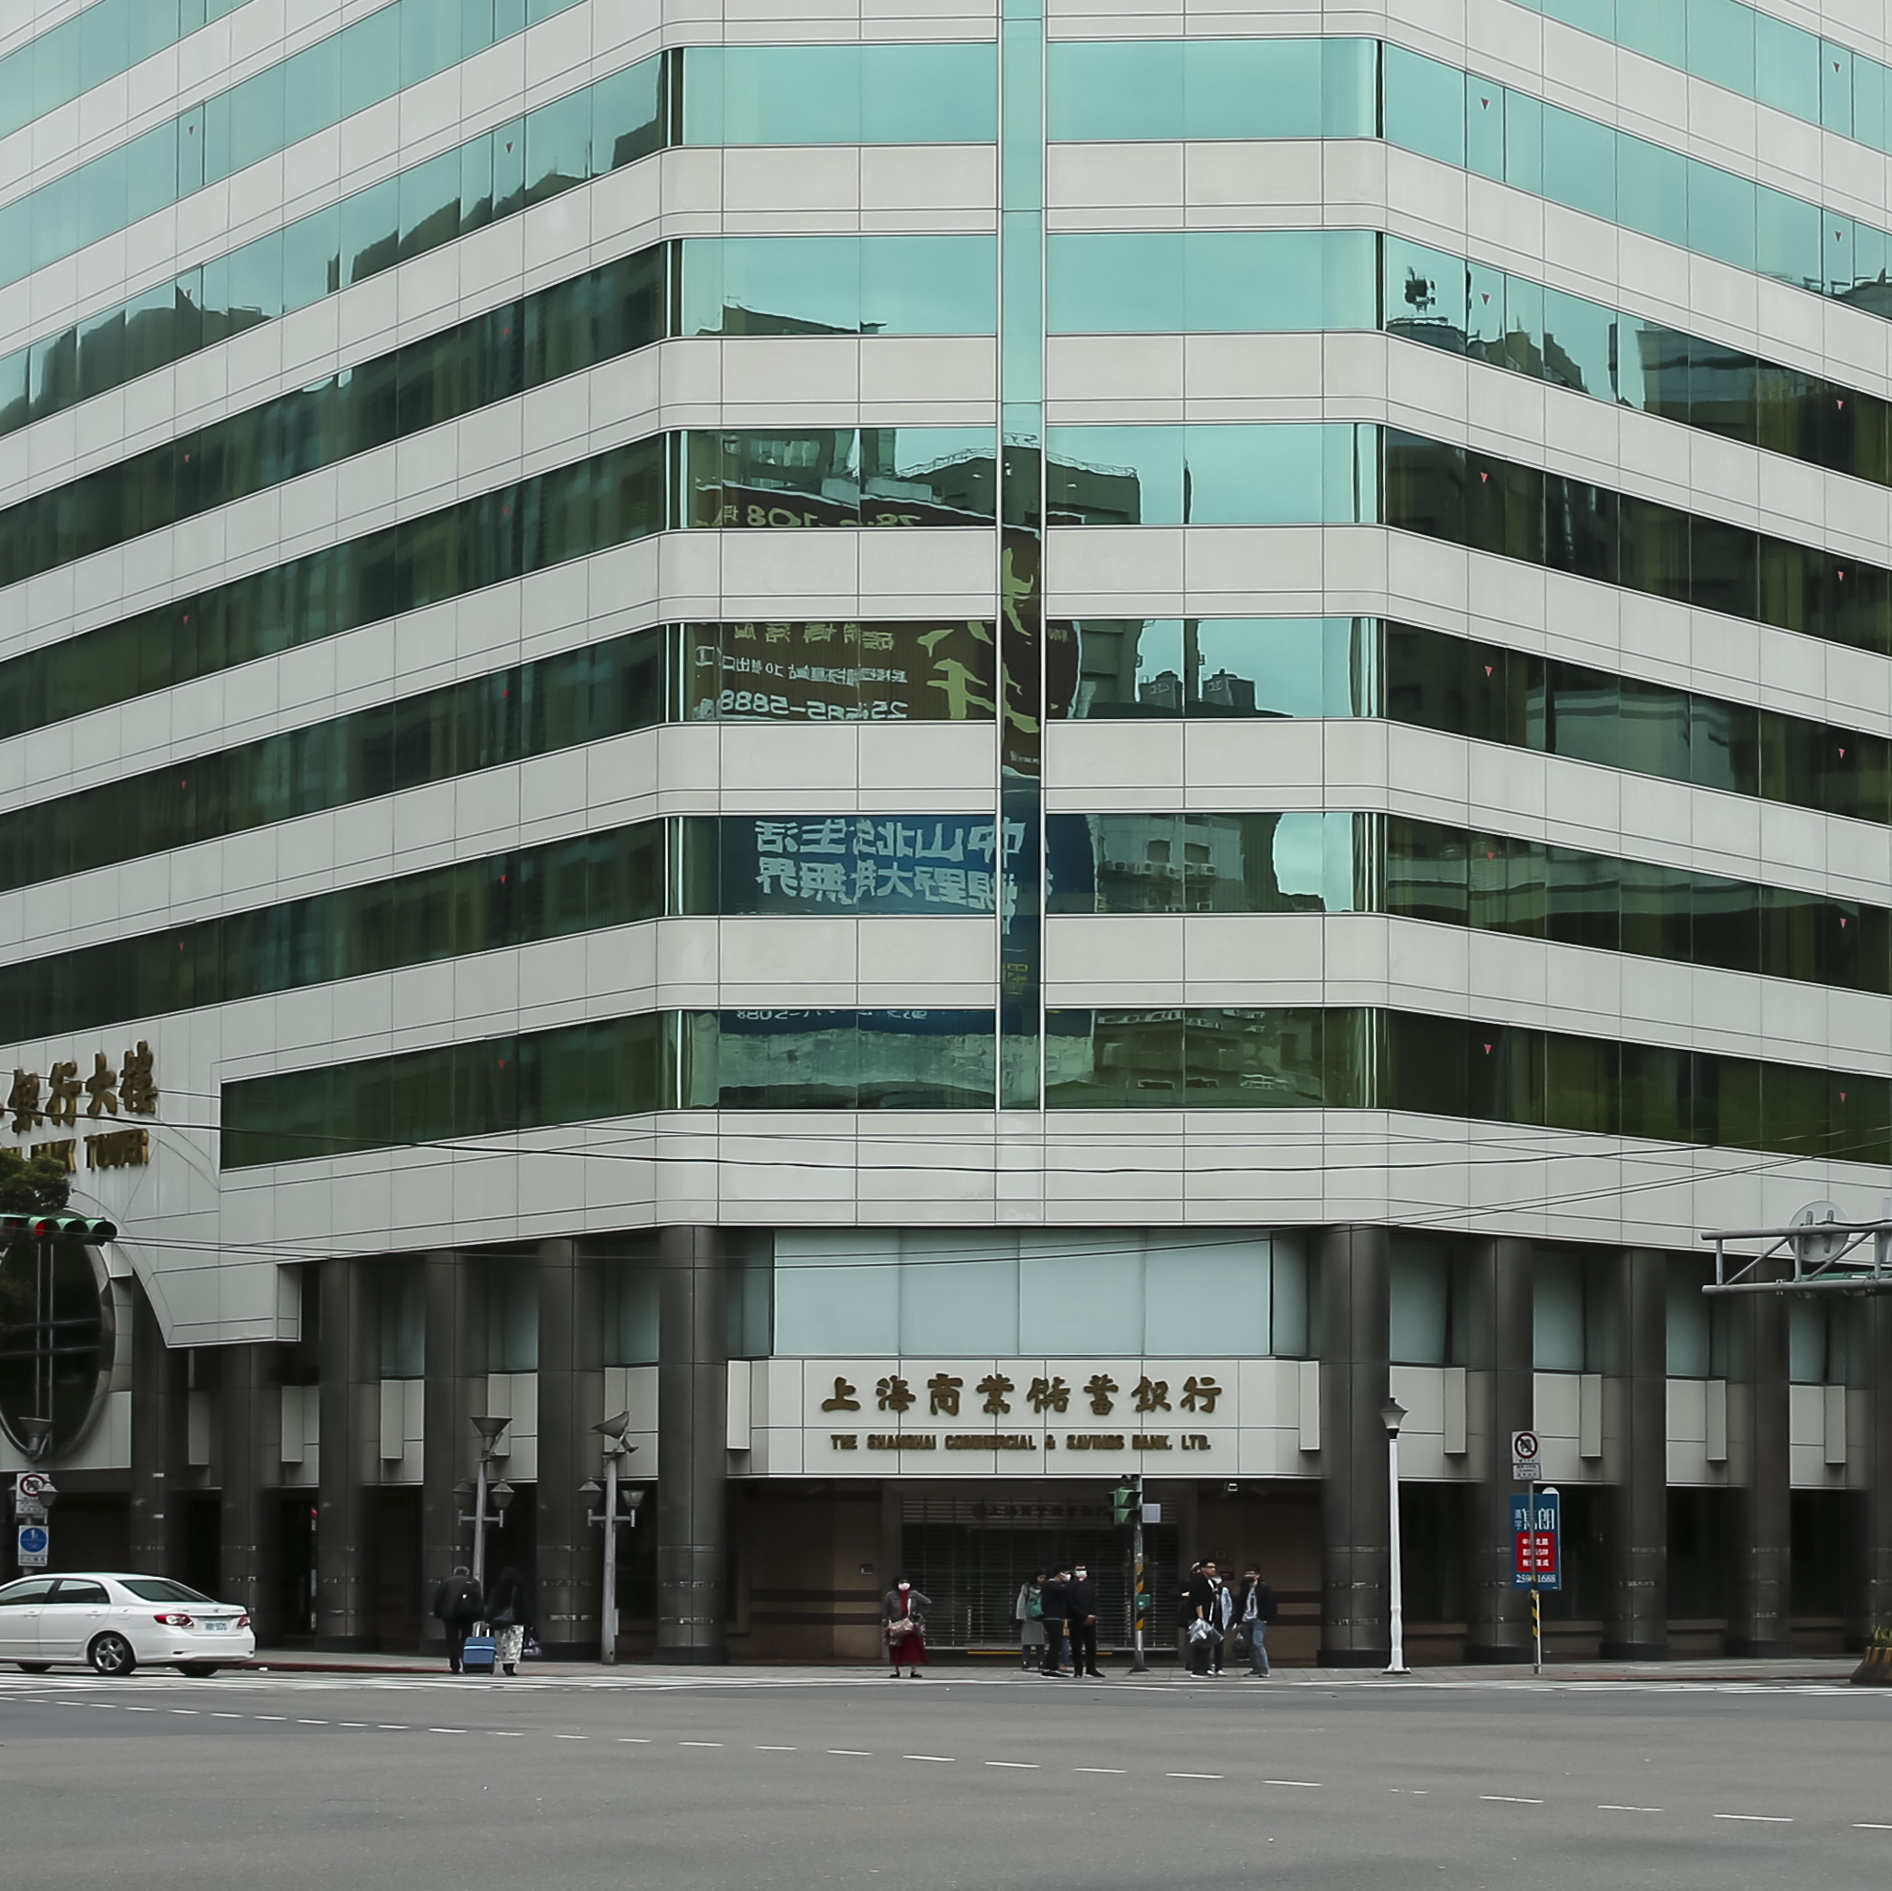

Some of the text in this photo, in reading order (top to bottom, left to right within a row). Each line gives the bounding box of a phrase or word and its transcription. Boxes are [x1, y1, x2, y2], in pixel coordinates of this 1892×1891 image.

[830, 1434, 858, 1450] THE
[867, 1434, 936, 1450] SHANGHAI
[945, 1434, 1037, 1450] COMMERCIAL
[1067, 1434, 1124, 1450] SAVINGS
[1181, 1434, 1211, 1450] LTD.
